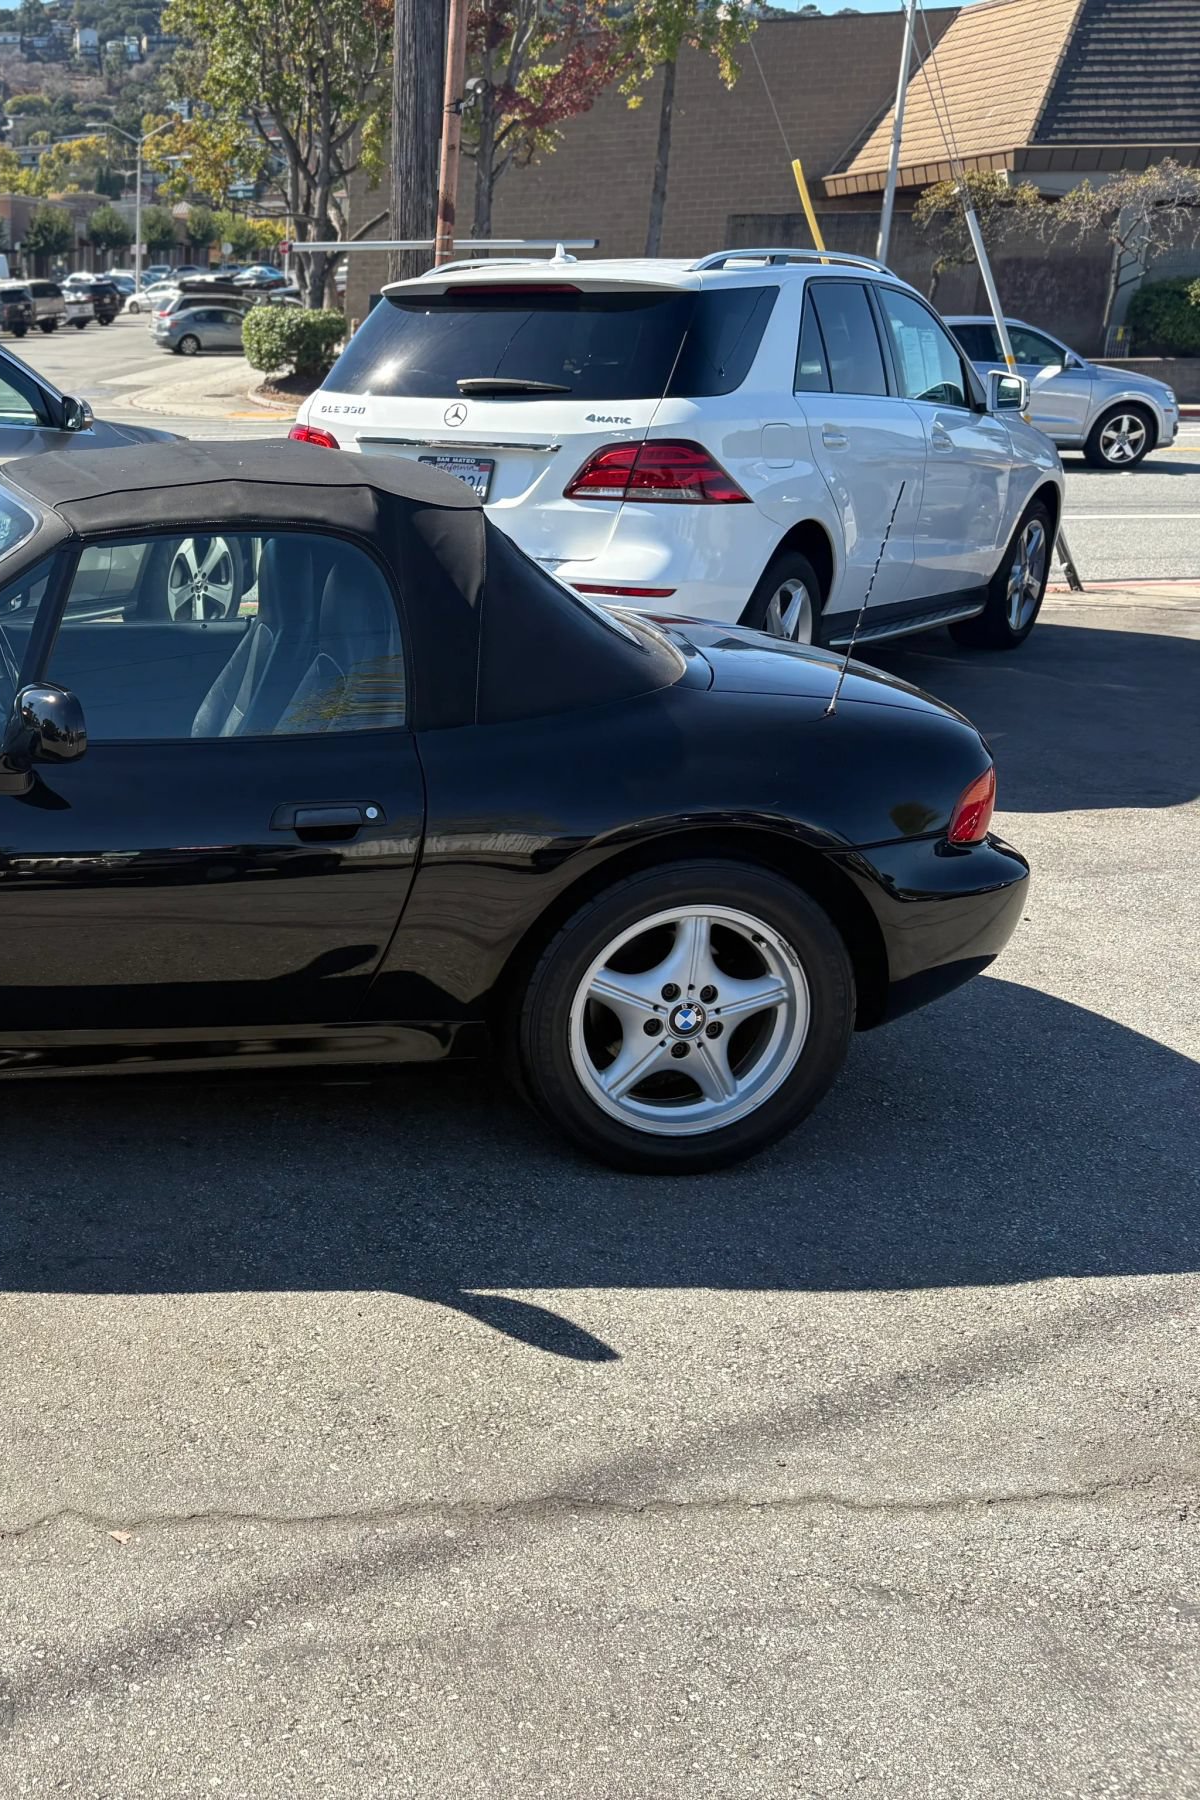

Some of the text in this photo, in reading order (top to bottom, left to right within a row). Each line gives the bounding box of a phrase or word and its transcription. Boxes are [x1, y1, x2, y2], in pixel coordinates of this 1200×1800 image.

[320, 405, 367, 415] GLE 350
[585, 413, 632, 425] 4MATIC
[681, 1003, 703, 1022] BMW
